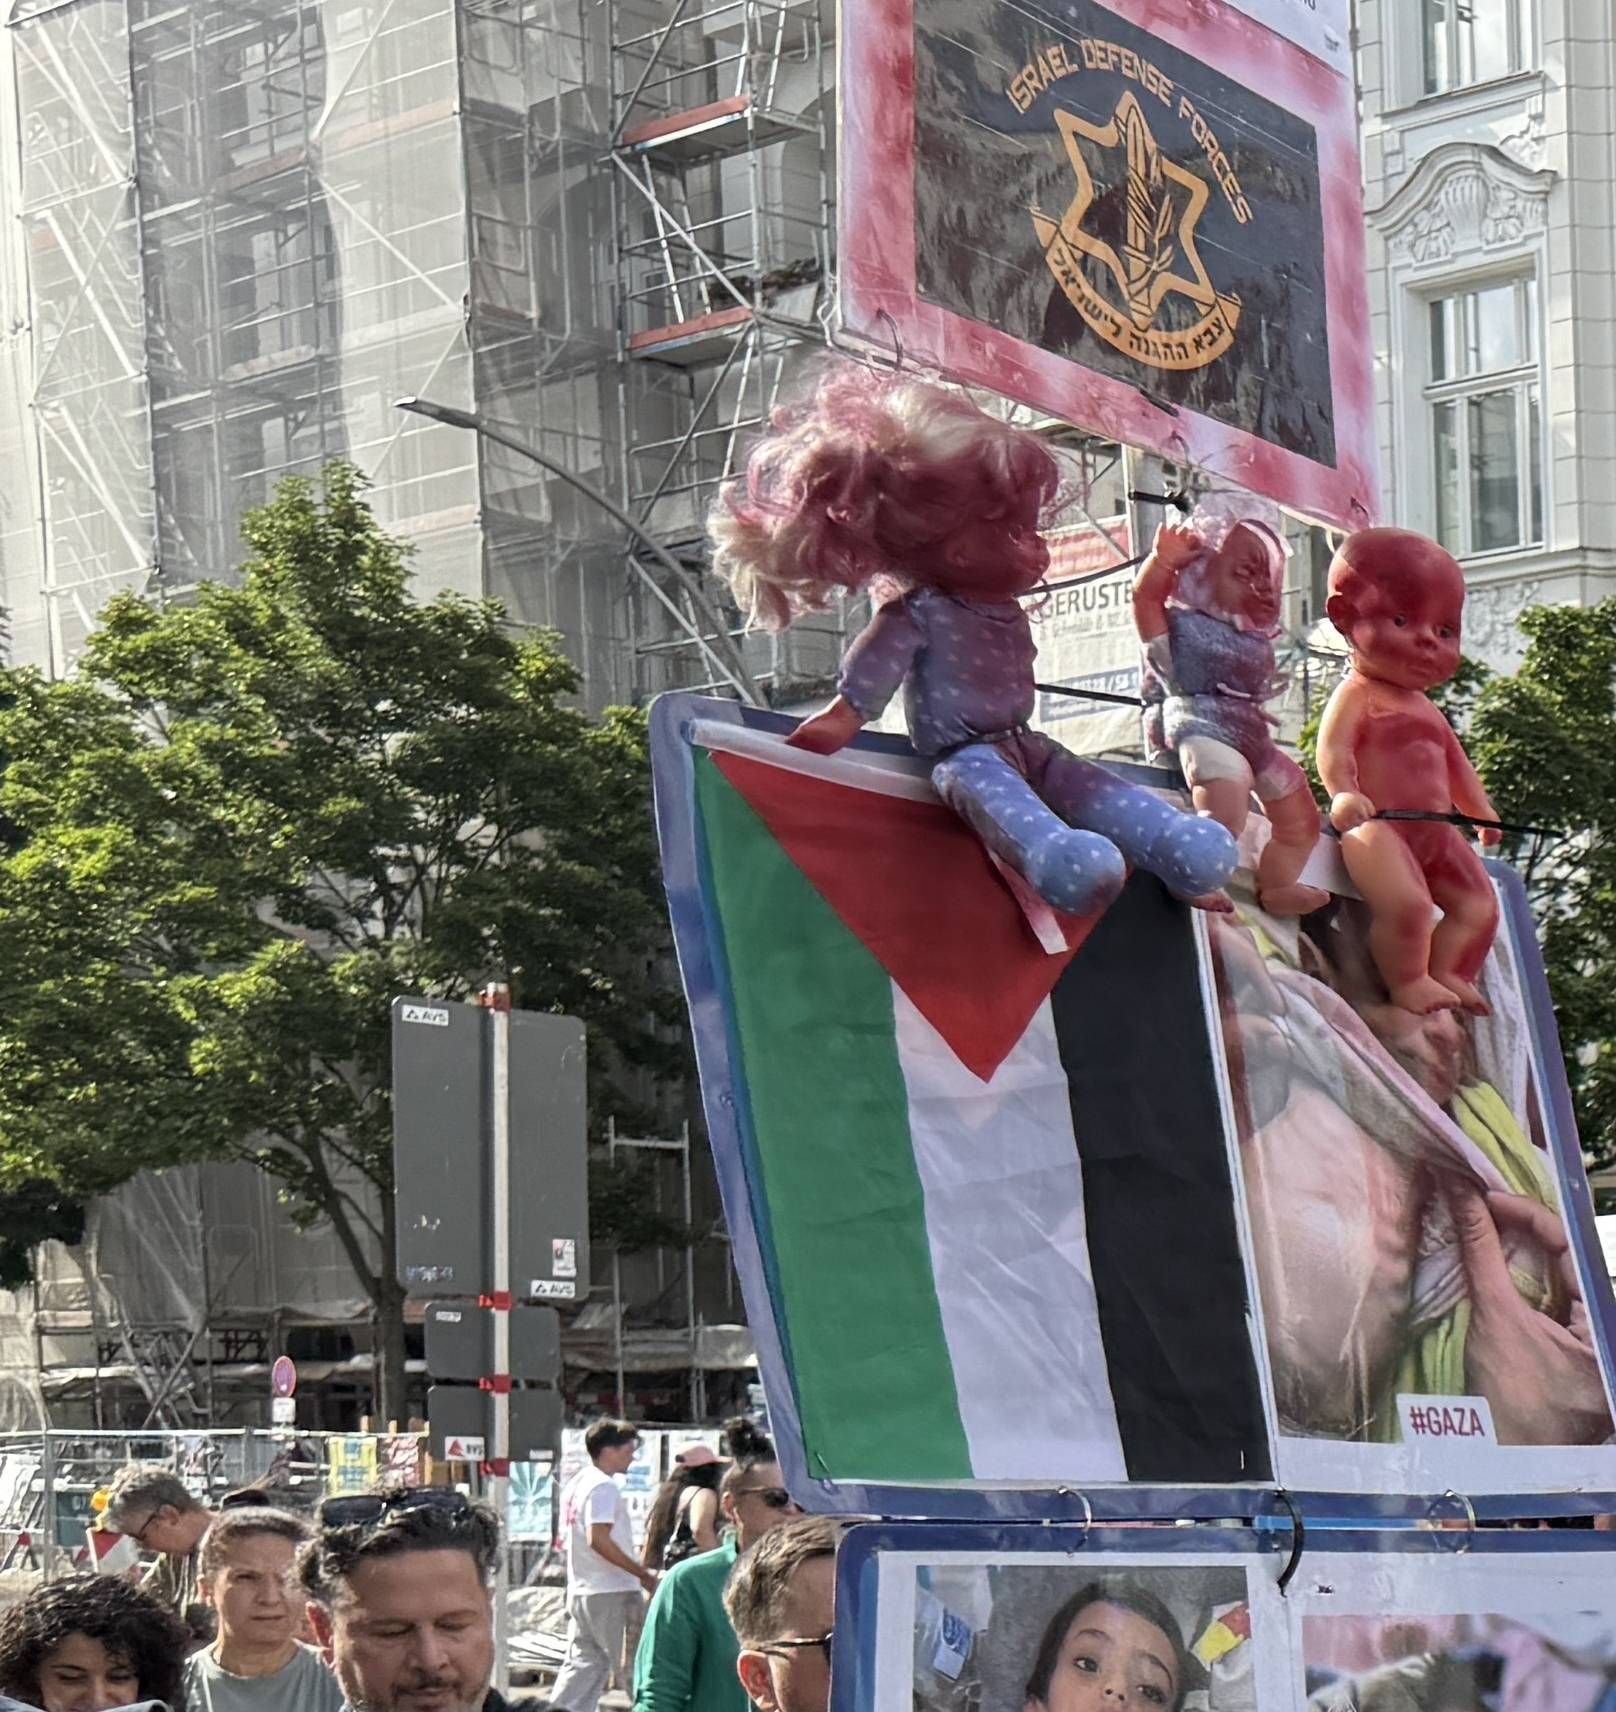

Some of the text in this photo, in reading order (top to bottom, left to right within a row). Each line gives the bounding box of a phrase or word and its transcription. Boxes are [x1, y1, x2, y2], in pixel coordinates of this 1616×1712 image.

[1006, 39, 1253, 224] ISRAEL DEFENSE FORCES
[1410, 1406, 1485, 1437] #GAZA
